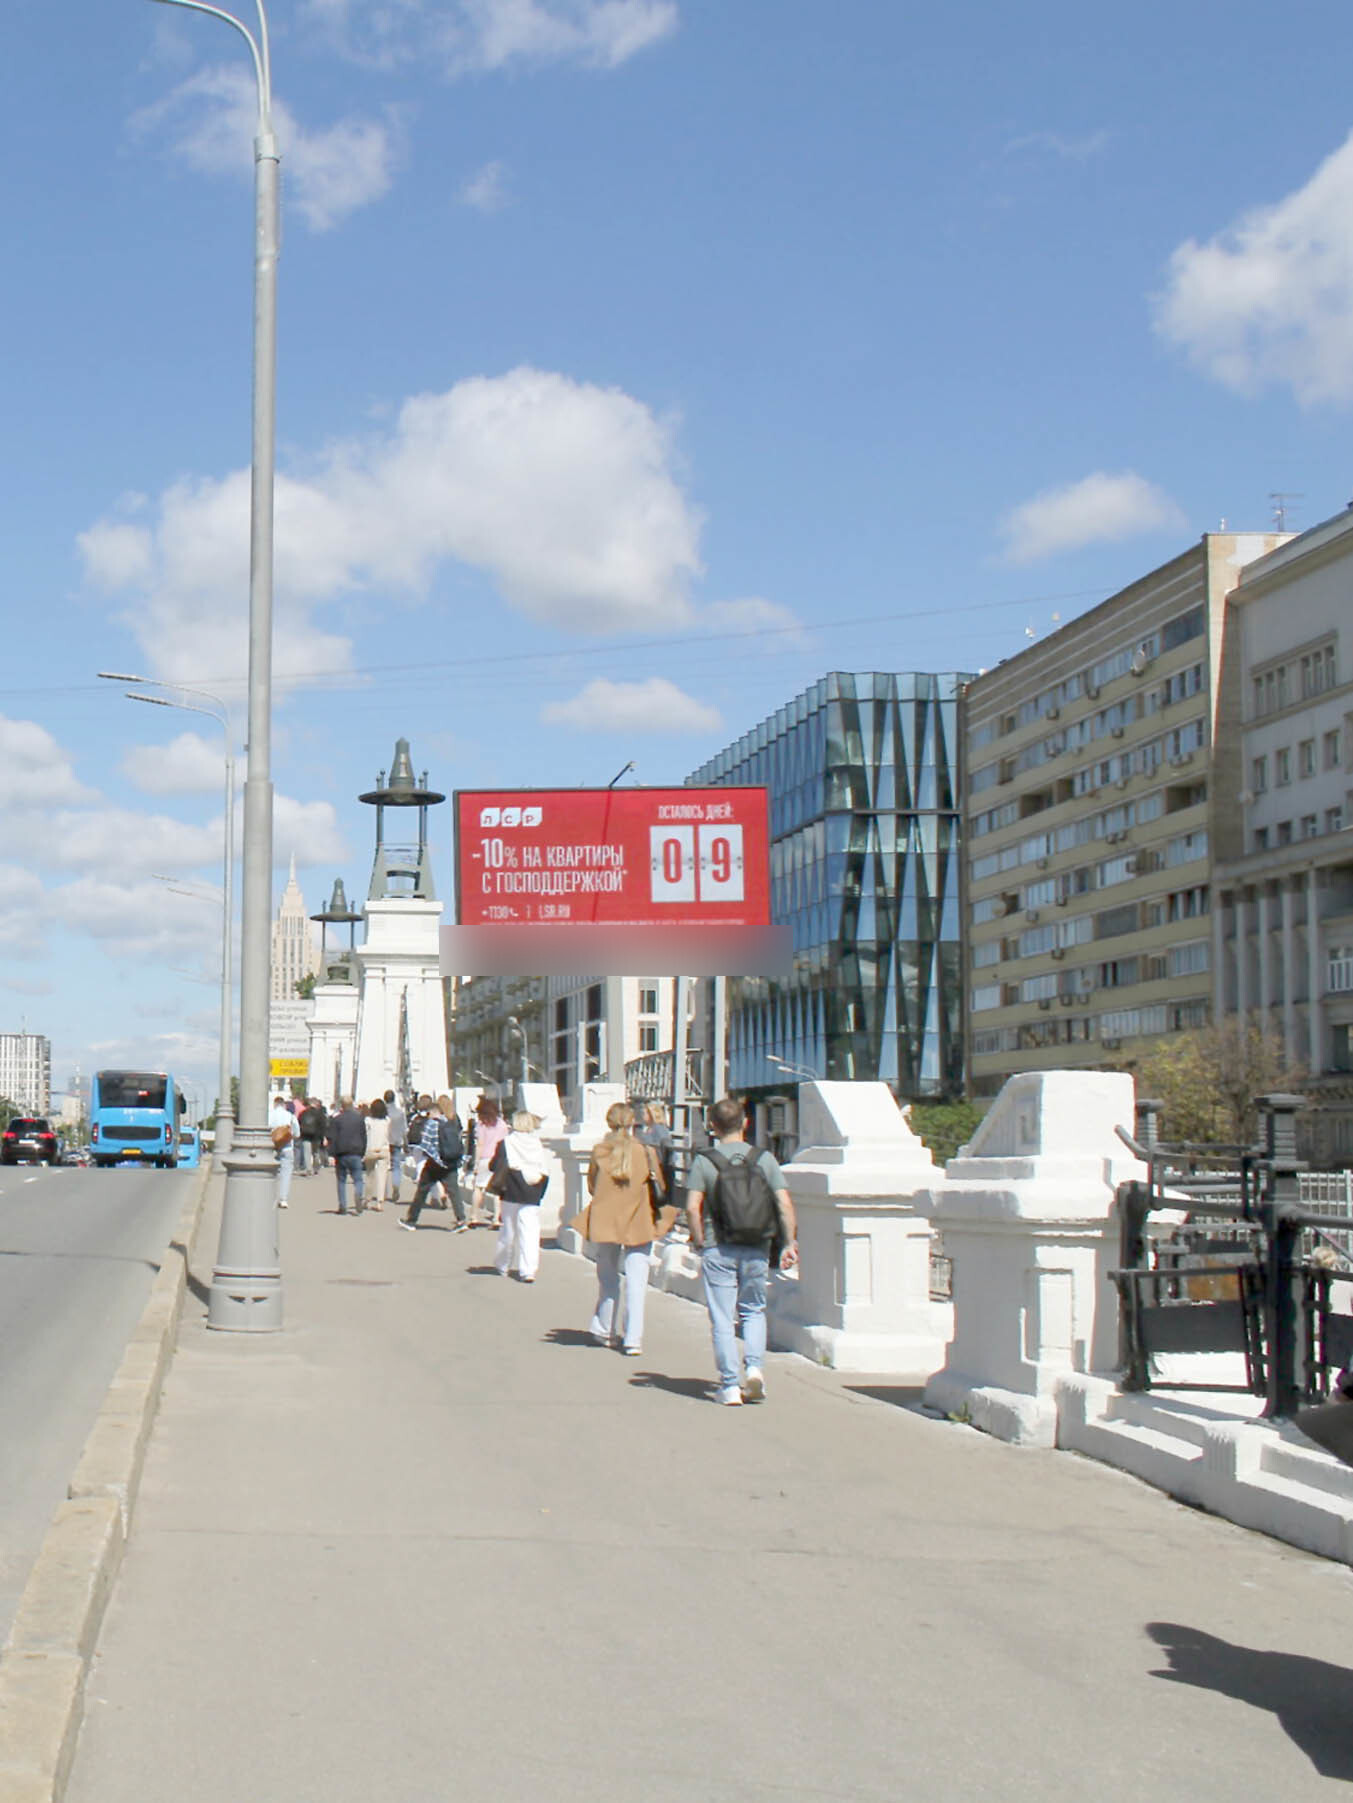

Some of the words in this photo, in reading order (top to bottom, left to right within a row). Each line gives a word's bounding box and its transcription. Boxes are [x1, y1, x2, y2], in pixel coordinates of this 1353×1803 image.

[658, 804, 704, 819] ОСТАЛОСЬ
[471, 838, 518, 868] -10%
[522, 846, 542, 868] НА
[546, 844, 624, 868] КВАРТИРЫ
[481, 872, 492, 894] С
